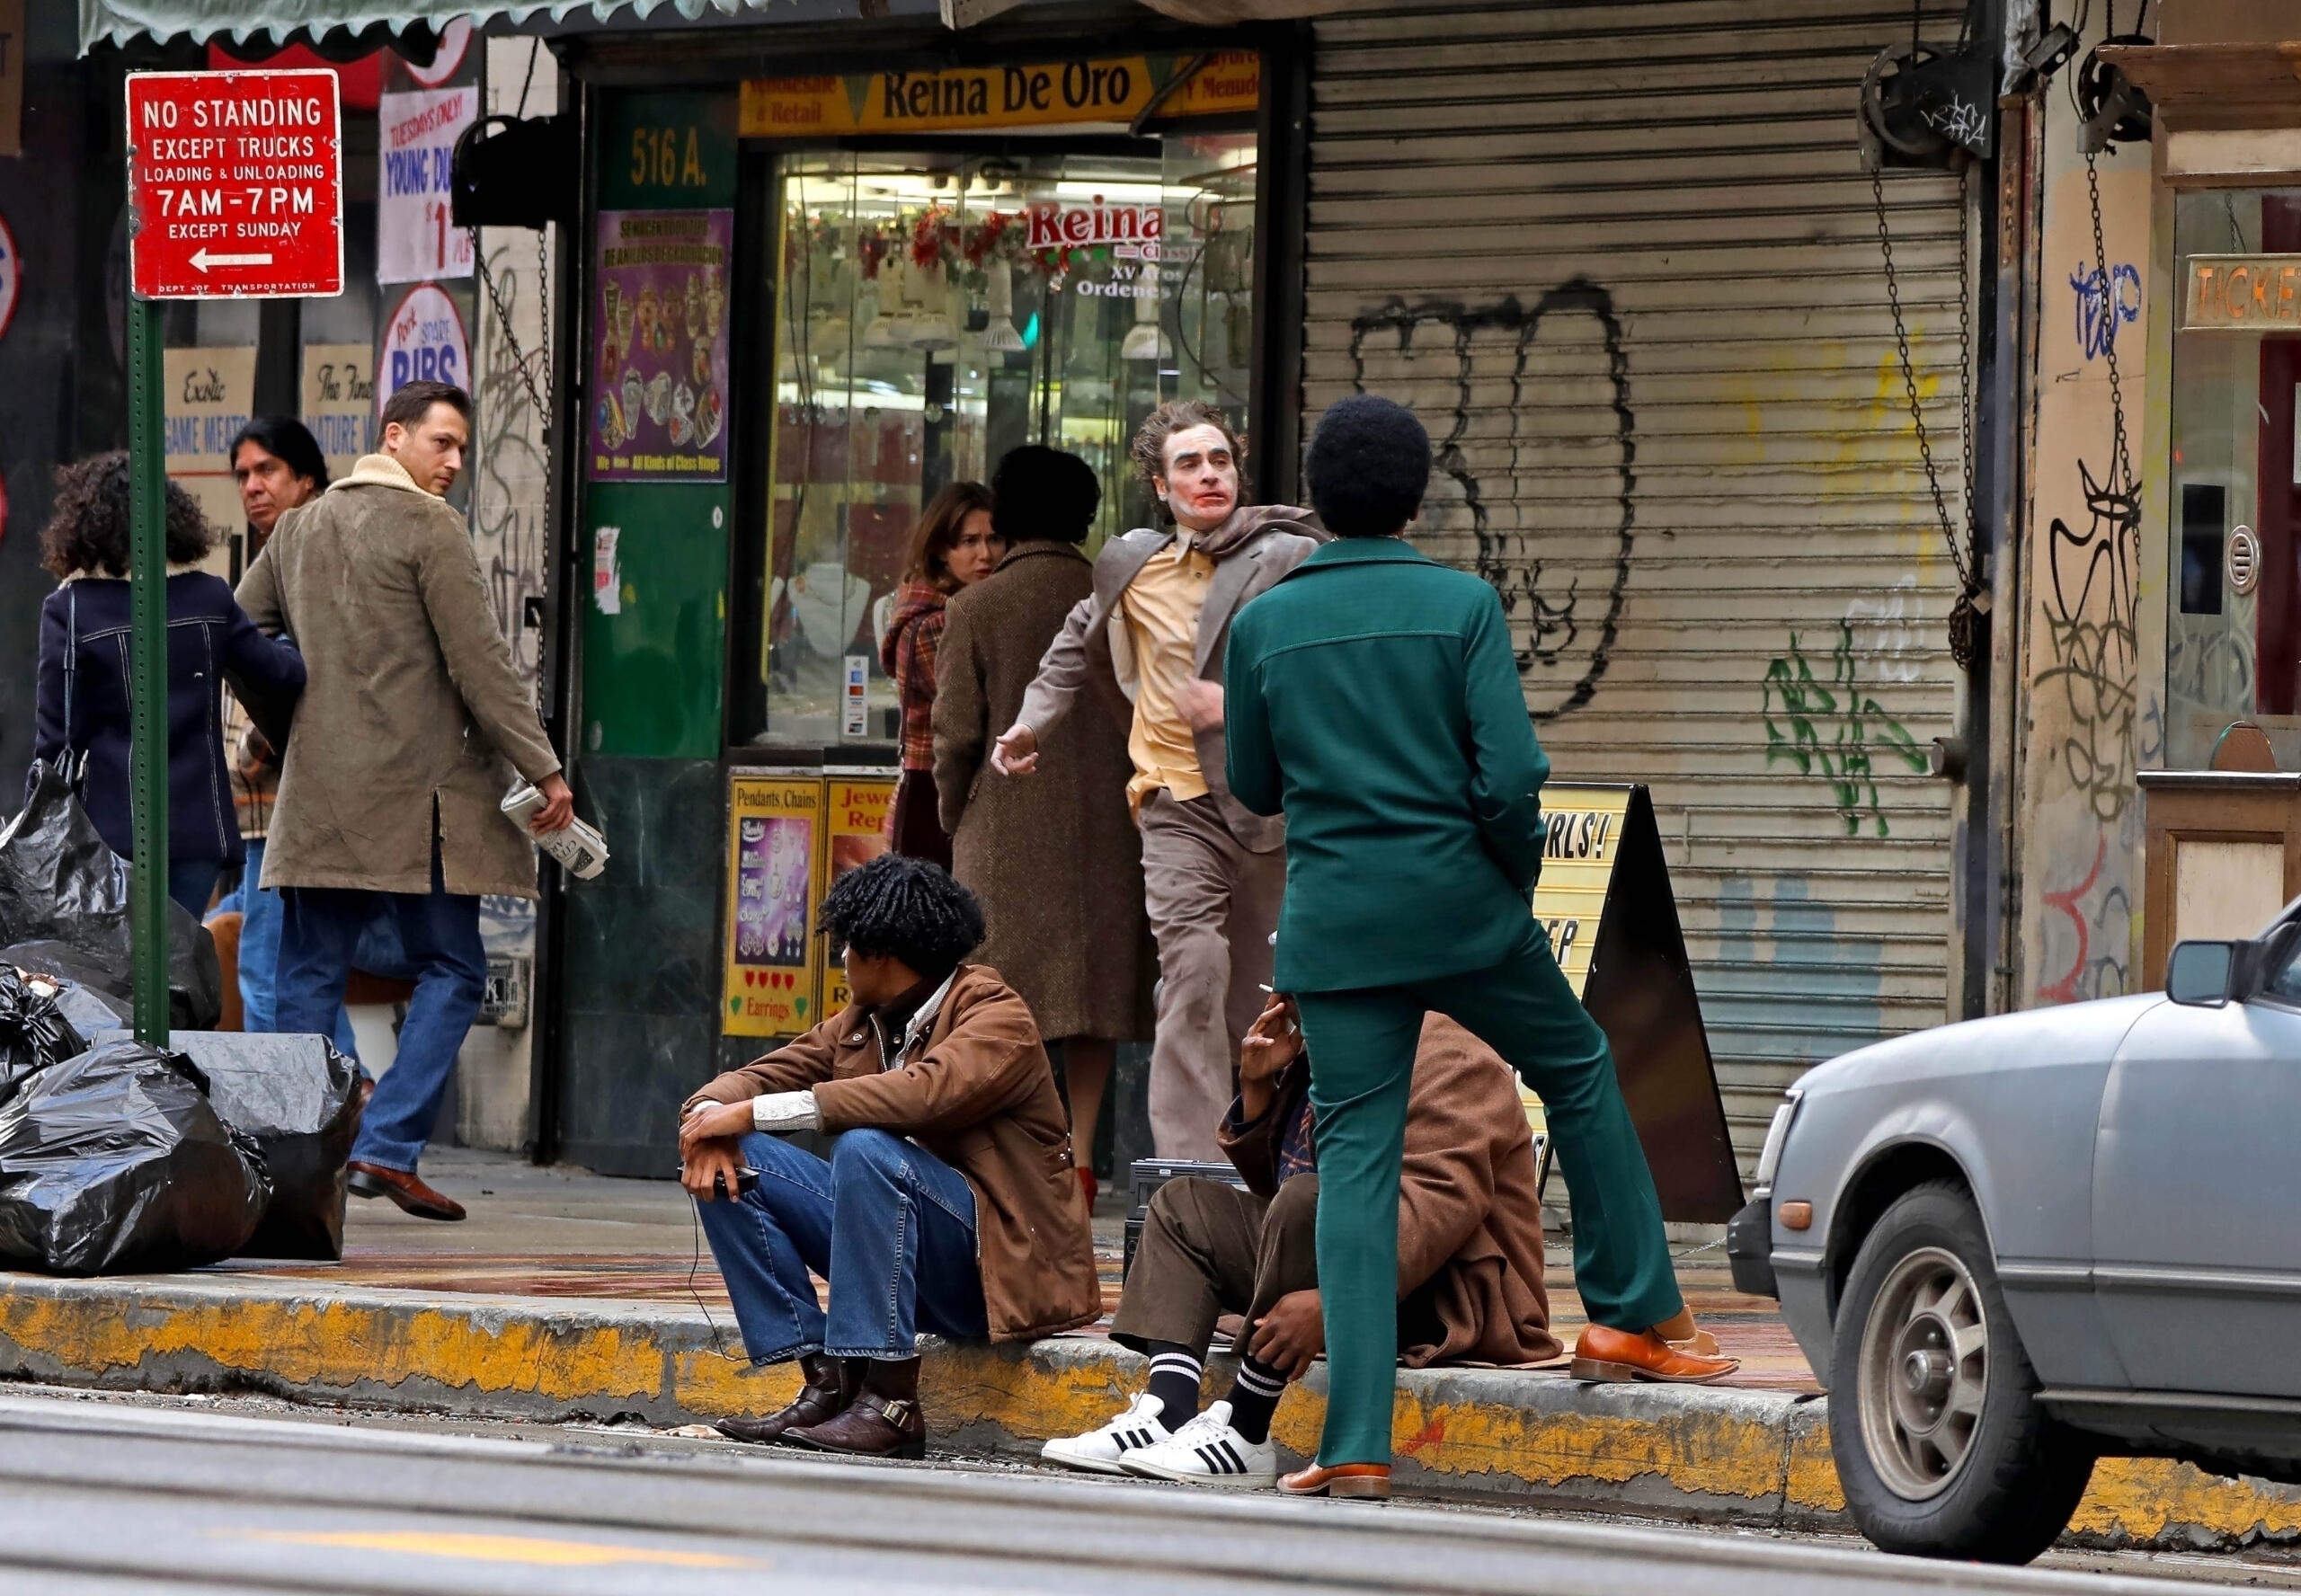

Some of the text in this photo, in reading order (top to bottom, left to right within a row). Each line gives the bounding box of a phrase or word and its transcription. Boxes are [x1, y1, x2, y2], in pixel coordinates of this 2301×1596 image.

[884, 62, 1131, 119] Reina De Oro
[1203, 73, 1257, 100] Menud
[144, 98, 321, 129] NO STANDING
[390, 107, 435, 148] TUESDAYS
[771, 101, 822, 124] Retail
[153, 137, 315, 160] EXCEPT TRUCKS
[632, 127, 676, 186] 516
[144, 164, 324, 182] LOADING & UNLOADING
[385, 146, 452, 198] YOUNG DU
[169, 222, 301, 239] EXCEPT SUNDAY
[1027, 194, 1163, 249] Reina
[221, 282, 315, 292] TRANSPORTATION
[1111, 266, 1136, 280] XV
[1076, 280, 1170, 299] Ordenes
[2197, 266, 2301, 319] TICKE
[397, 306, 417, 348] Pork
[183, 367, 225, 403] Exotic
[317, 364, 372, 402] The Fine
[164, 415, 200, 455] GAME
[737, 786, 817, 810] Pendants, Chains
[840, 787, 891, 809] Jewe
[1541, 811, 1611, 859] IRLS!
[747, 997, 791, 1022] Earrings
